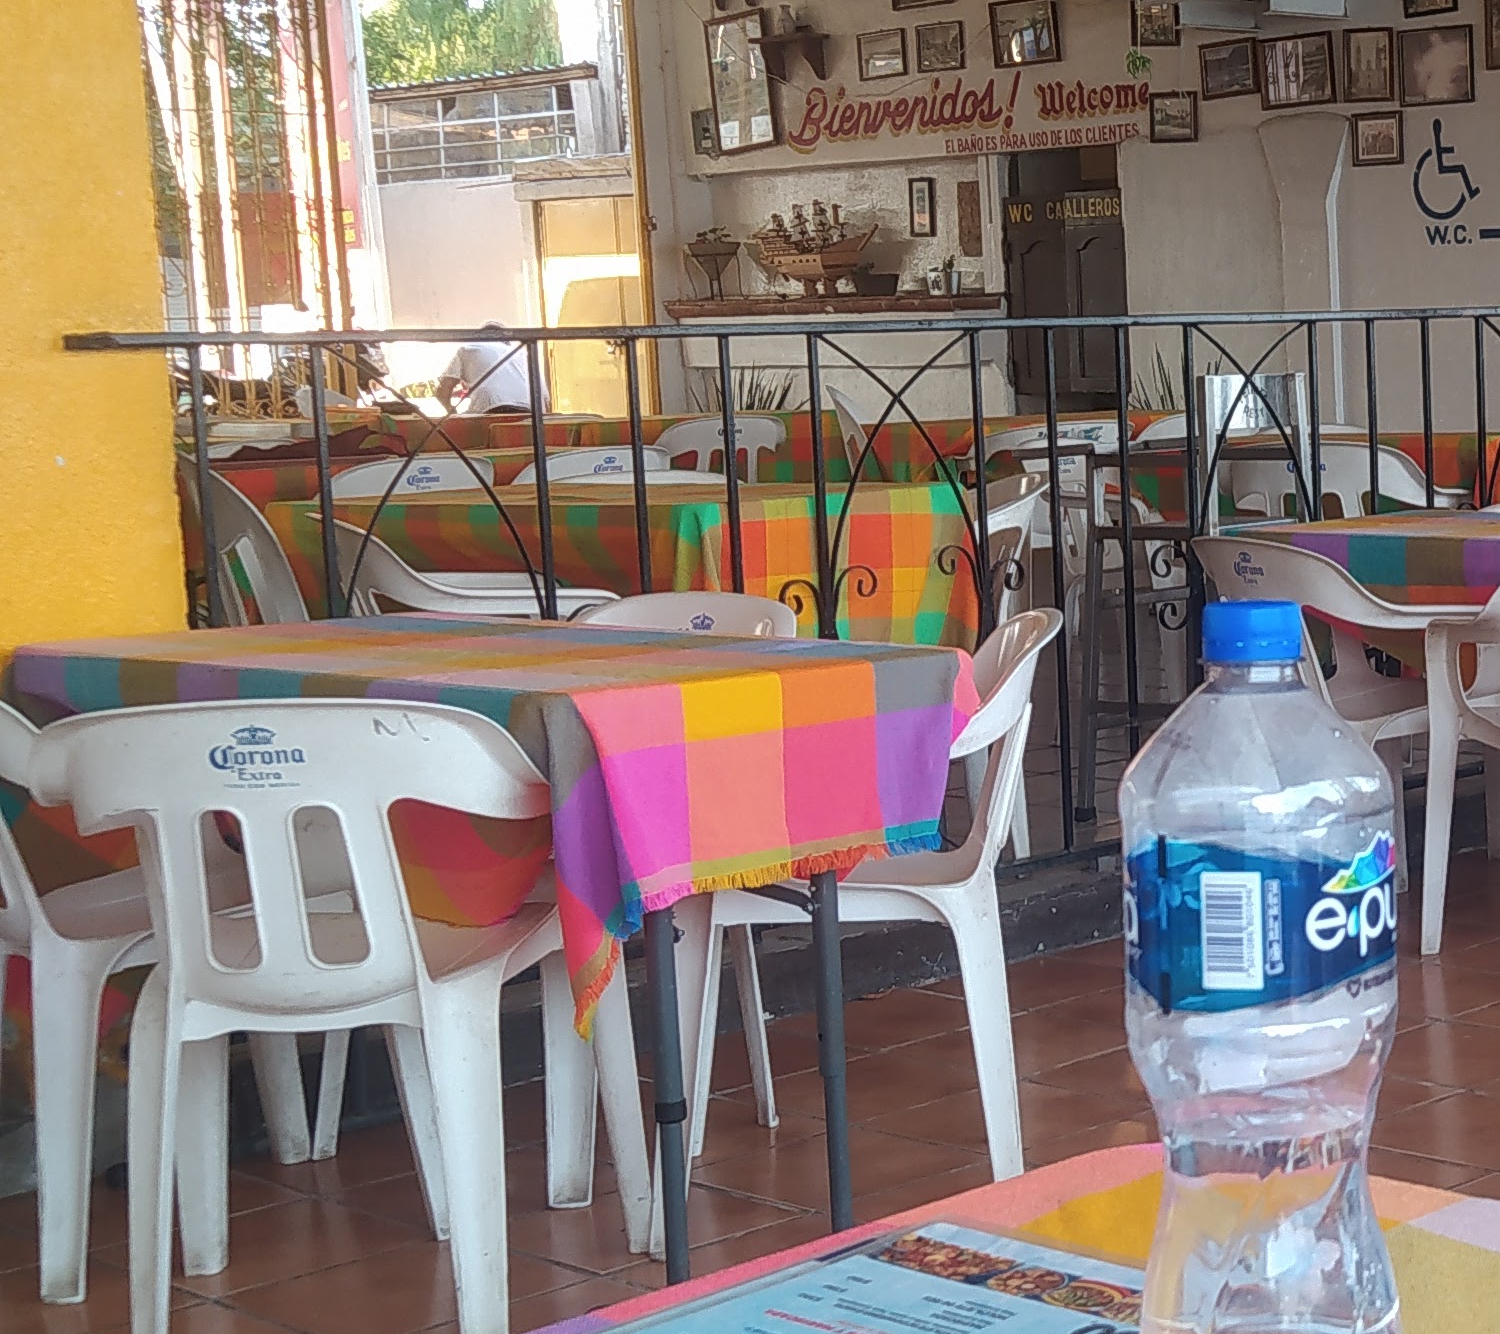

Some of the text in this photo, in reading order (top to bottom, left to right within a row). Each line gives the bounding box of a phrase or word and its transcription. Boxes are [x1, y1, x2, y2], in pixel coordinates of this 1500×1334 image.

[788, 70, 1150, 152] Bienvenidos! Welcome
[945, 123, 1140, 154] EL BAÑO ES PARA USO DE LOS CLIENTES
[1008, 203, 1033, 223] WC
[1425, 225, 1472, 246] W.C.
[209, 744, 306, 771] Corona
[236, 769, 283, 782] Extra
